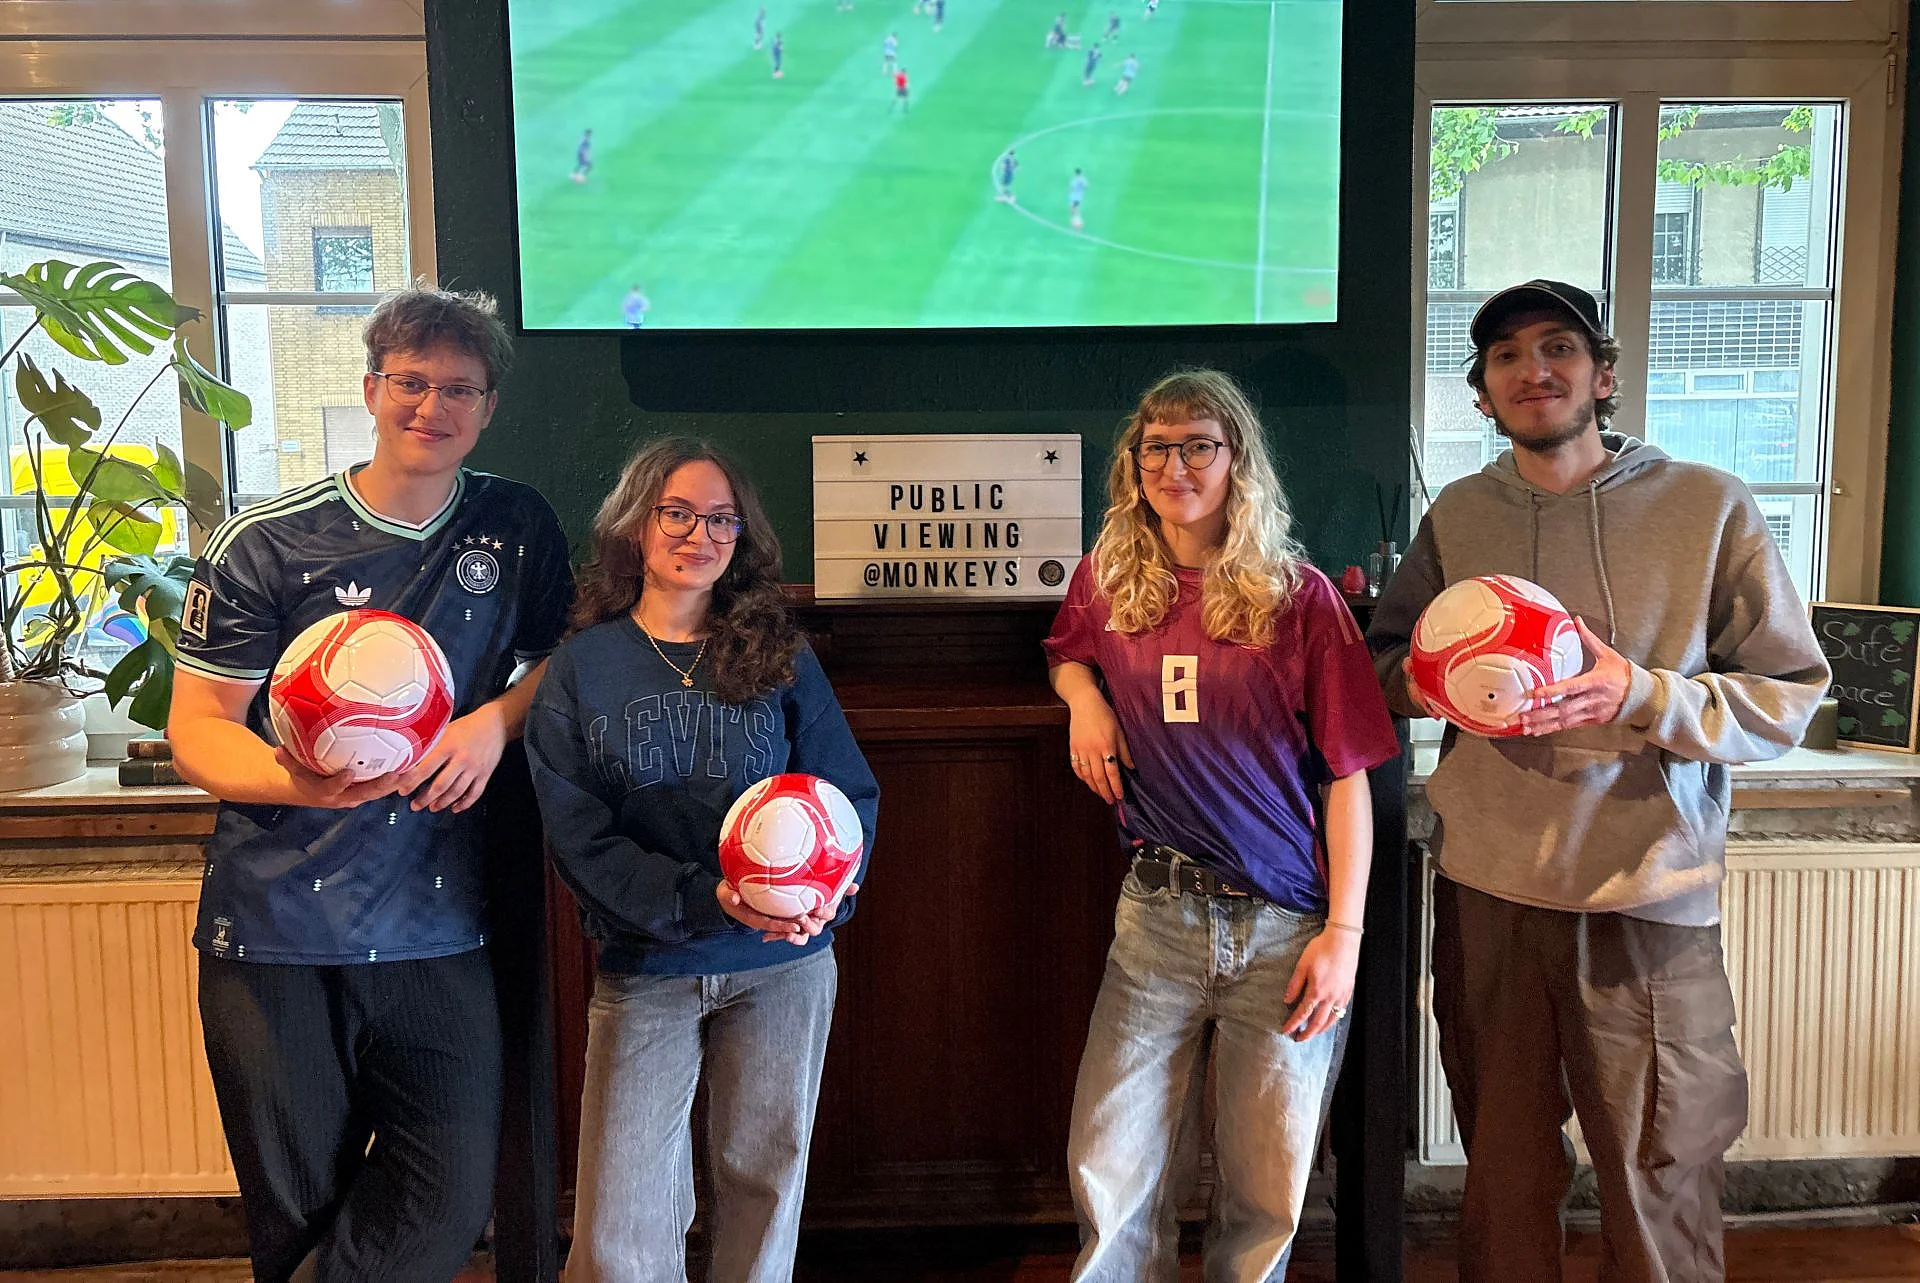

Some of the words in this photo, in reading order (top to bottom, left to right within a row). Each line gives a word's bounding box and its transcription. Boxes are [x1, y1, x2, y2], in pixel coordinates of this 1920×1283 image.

[890, 484, 1003, 512] PUBLIC
[874, 522, 1020, 549] VIEWING
[864, 561, 1018, 587] @MONKEYS
[1823, 621, 1902, 667] Safe
[1162, 655, 1199, 722] 8
[1830, 684, 1896, 707] pace
[589, 690, 775, 792] LEVI'S
